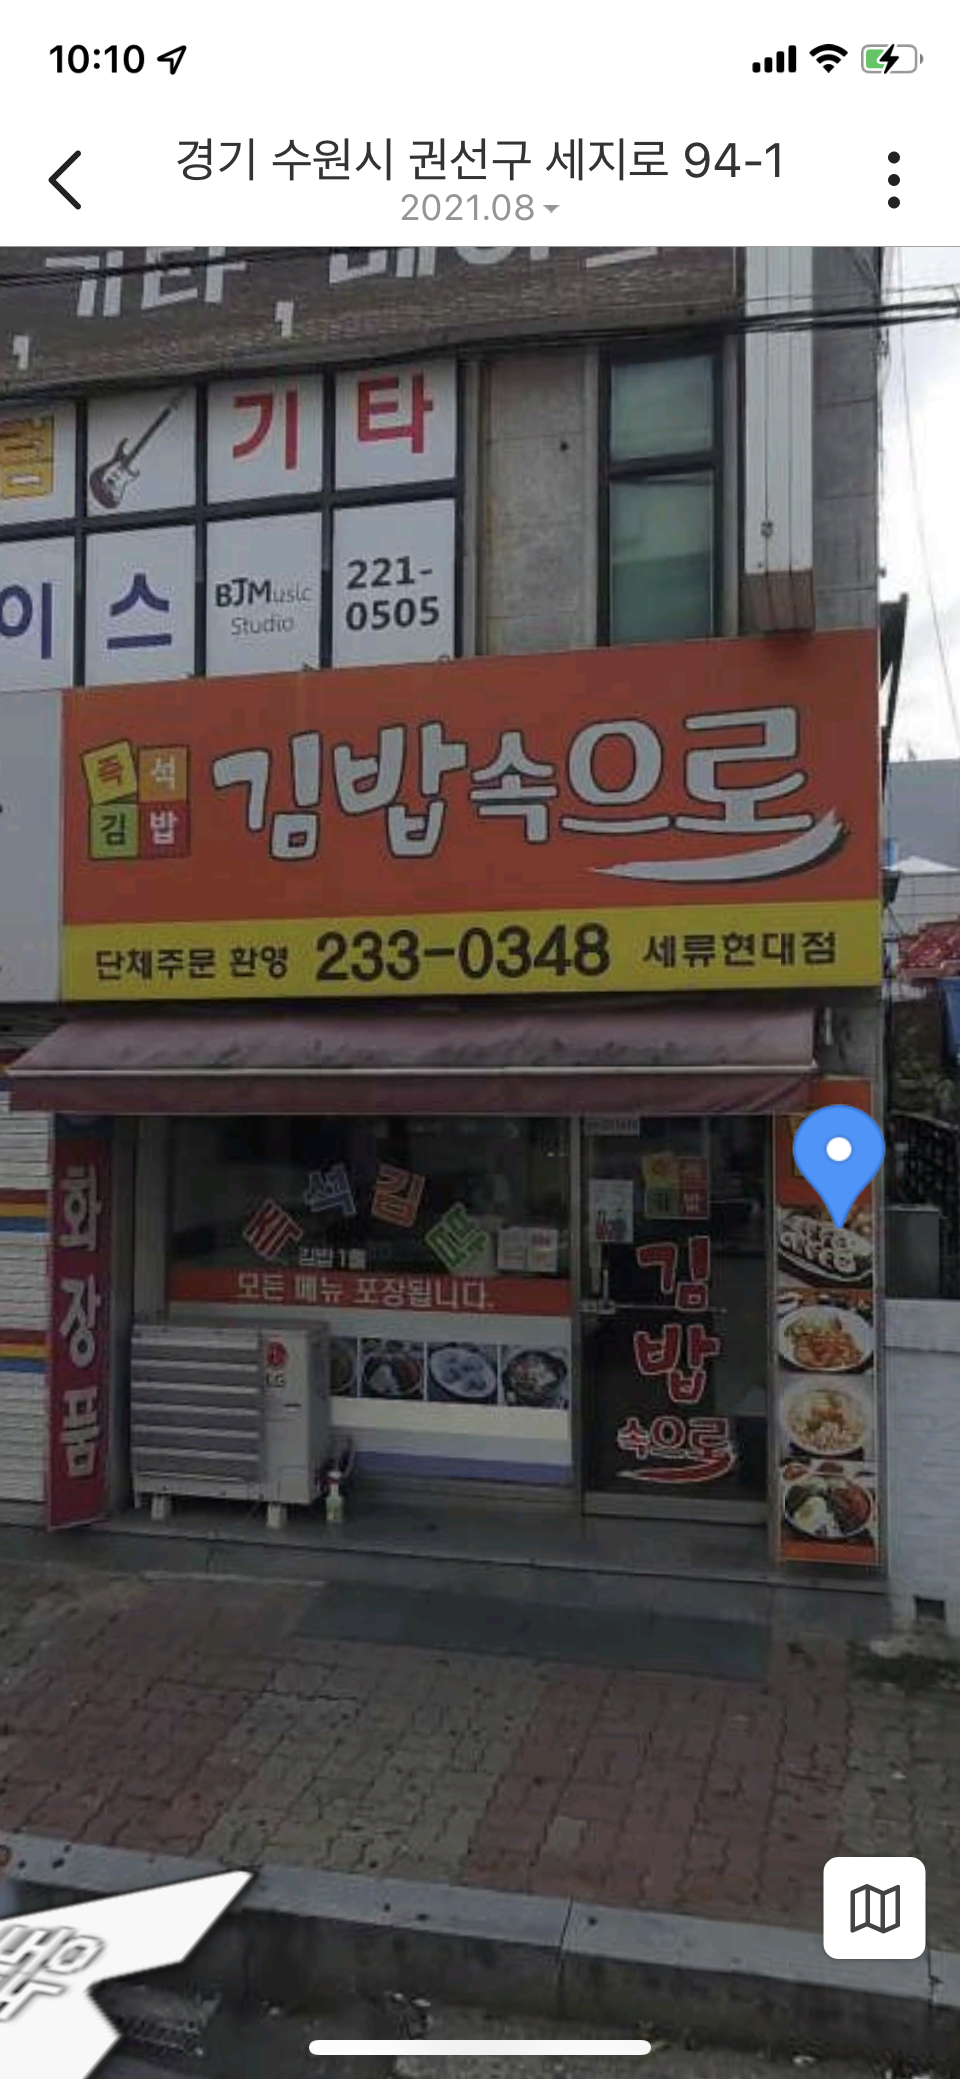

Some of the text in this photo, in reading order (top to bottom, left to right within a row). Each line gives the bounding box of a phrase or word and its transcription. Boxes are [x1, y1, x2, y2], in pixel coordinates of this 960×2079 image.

[346, 555, 434, 590] 221-
[230, 616, 295, 637] Studio
[345, 595, 440, 632] 0505
[95, 923, 838, 983] 단체주문 환영 233-0348 세류현대점
[237, 1272, 286, 1302] 모든
[294, 1275, 345, 1304] 메뉴
[59, 1164, 102, 1478] 화장품
